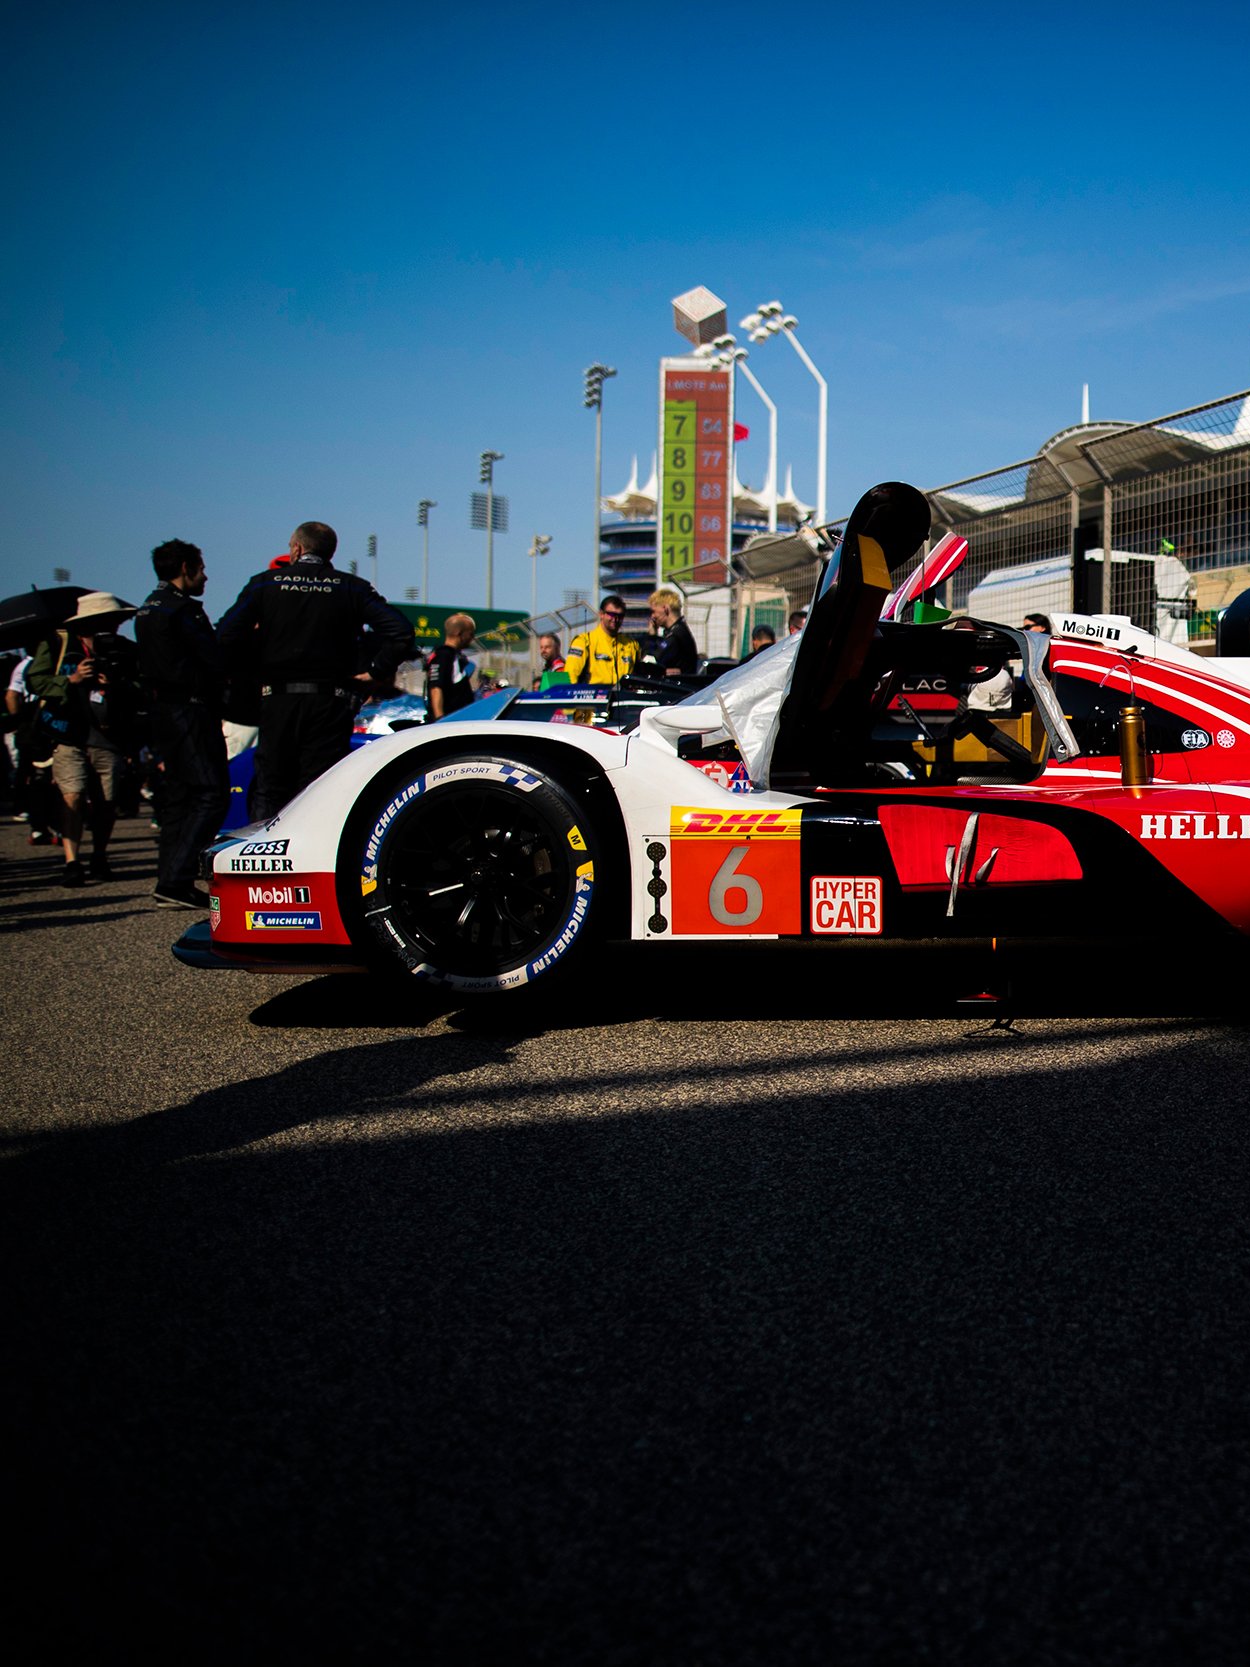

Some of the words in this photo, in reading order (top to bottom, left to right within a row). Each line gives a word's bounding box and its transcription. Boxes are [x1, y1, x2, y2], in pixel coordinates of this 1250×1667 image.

[673, 415, 687, 437] 7
[673, 447, 686, 469] 8
[702, 450, 721, 467] 77
[672, 480, 686, 502] 9
[665, 512, 692, 534] 10
[665, 545, 689, 567] 11
[273, 575, 341, 584] CADILLAC
[280, 585, 332, 593] RACING
[1062, 620, 1104, 638] Mobil
[1108, 628, 1119, 640] 1
[1184, 733, 1209, 747] FIA
[433, 768, 458, 781] PILOT
[460, 767, 491, 775] SPORT
[366, 781, 420, 861] MICHELIN
[684, 813, 787, 833] DHL
[242, 841, 286, 855] BOSS
[570, 834, 581, 845] M
[231, 859, 293, 871] HELLER
[248, 886, 293, 904] Mobil
[296, 887, 309, 903] 1
[709, 845, 764, 927] 6
[815, 882, 877, 899] HYPER
[266, 917, 315, 926] MICHELIN
[816, 901, 877, 929] CAR
[532, 895, 588, 975] MICHELIN
[495, 975, 520, 987] PILOT
